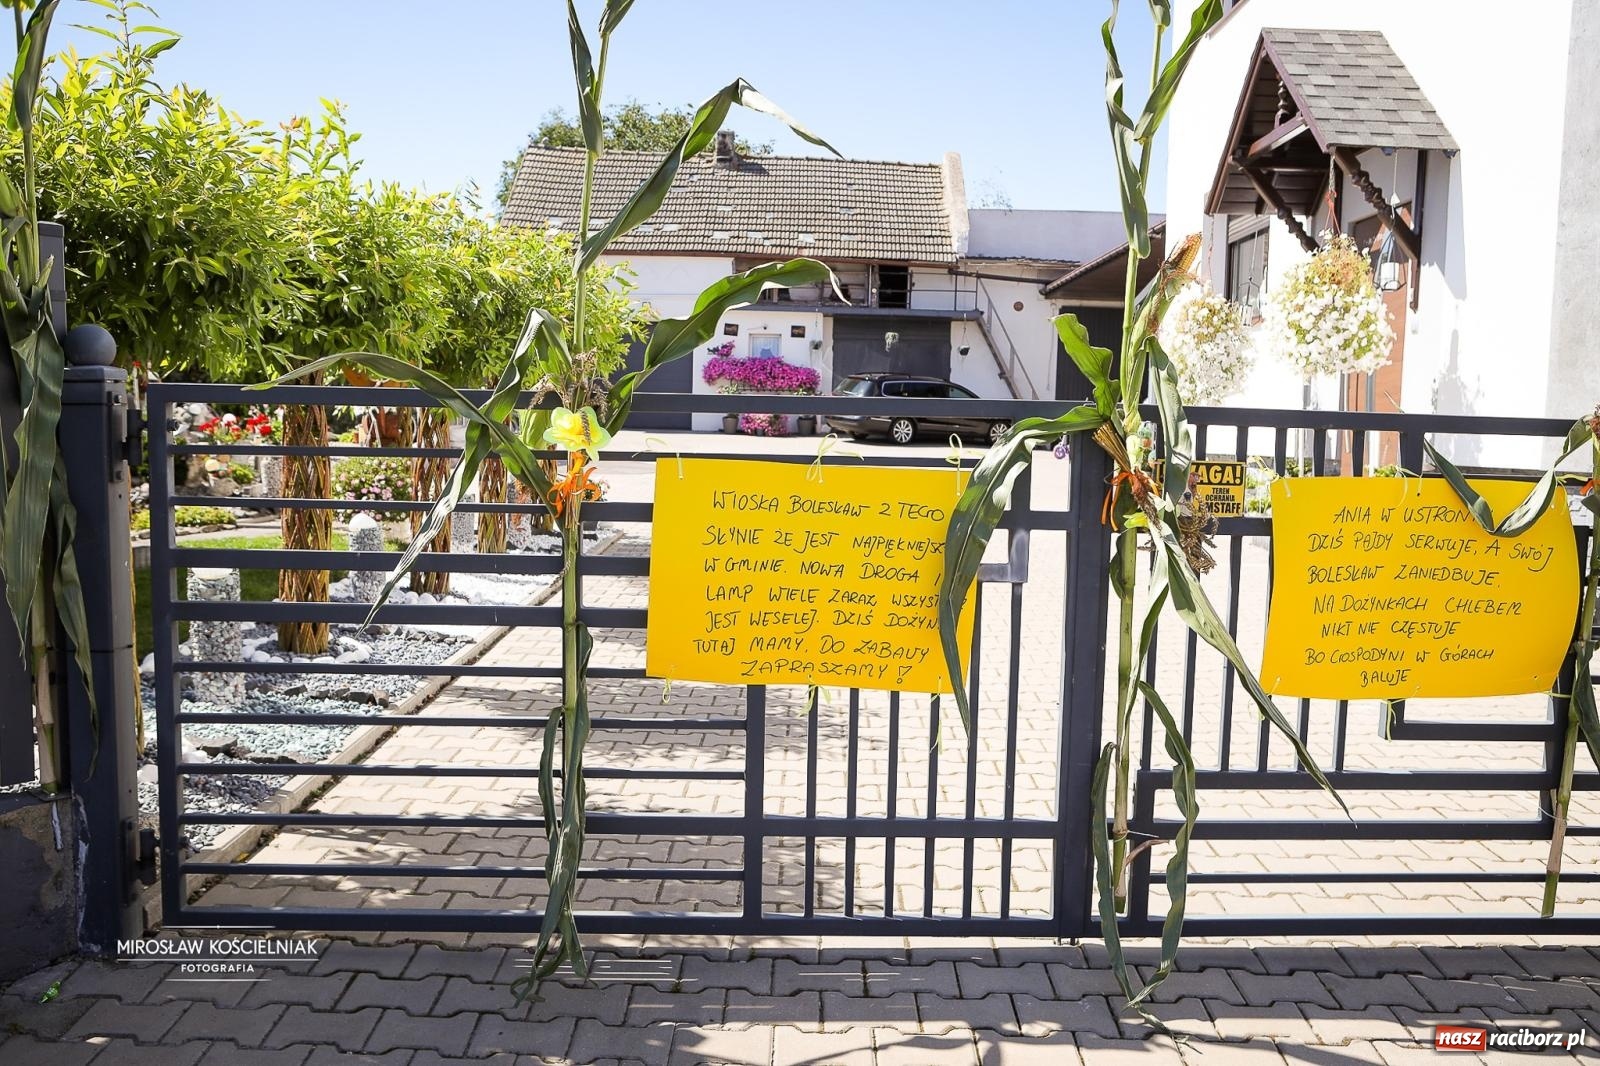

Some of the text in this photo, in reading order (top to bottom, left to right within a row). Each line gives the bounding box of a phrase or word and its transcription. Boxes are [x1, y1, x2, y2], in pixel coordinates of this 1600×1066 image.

[1157, 464, 1242, 484] AGA!
[1205, 494, 1236, 502] OCHRANIA
[1212, 487, 1230, 495] TEREN
[713, 490, 779, 513] WIOSKA
[786, 494, 870, 518] BOLESŁAW
[898, 502, 945, 522] TEGO
[1199, 502, 1241, 514] MSTAFF
[1333, 505, 1493, 524] ANIA W USTRON
[702, 525, 945, 560] SŁYNIE ŻE JEST NAJPIĘKNIEJSZ
[1307, 528, 1554, 572] DZIŚ PAJDY SERWUJE, A SWÓJ
[704, 556, 720, 573] W
[725, 557, 787, 573] GMINIE.
[800, 561, 844, 579] NOWA
[859, 562, 920, 583] DROGA
[1307, 565, 1384, 584] BOLESŁAW
[706, 584, 966, 608] LAMP WIELE ZARAZ WSZYST
[1313, 593, 1522, 616] NA DOŻYNKACH CHLEBEM
[705, 609, 939, 634] JEST WESELEJ. DZIŚ DOŻYN
[1321, 620, 1461, 640] NIKT NIE CZĘSTUJE
[693, 637, 735, 656] TUTAJ
[820, 634, 845, 654] DO
[1304, 643, 1495, 666] BO GOSPODYNI W GÓRACH
[1360, 668, 1411, 688] BALUJE
